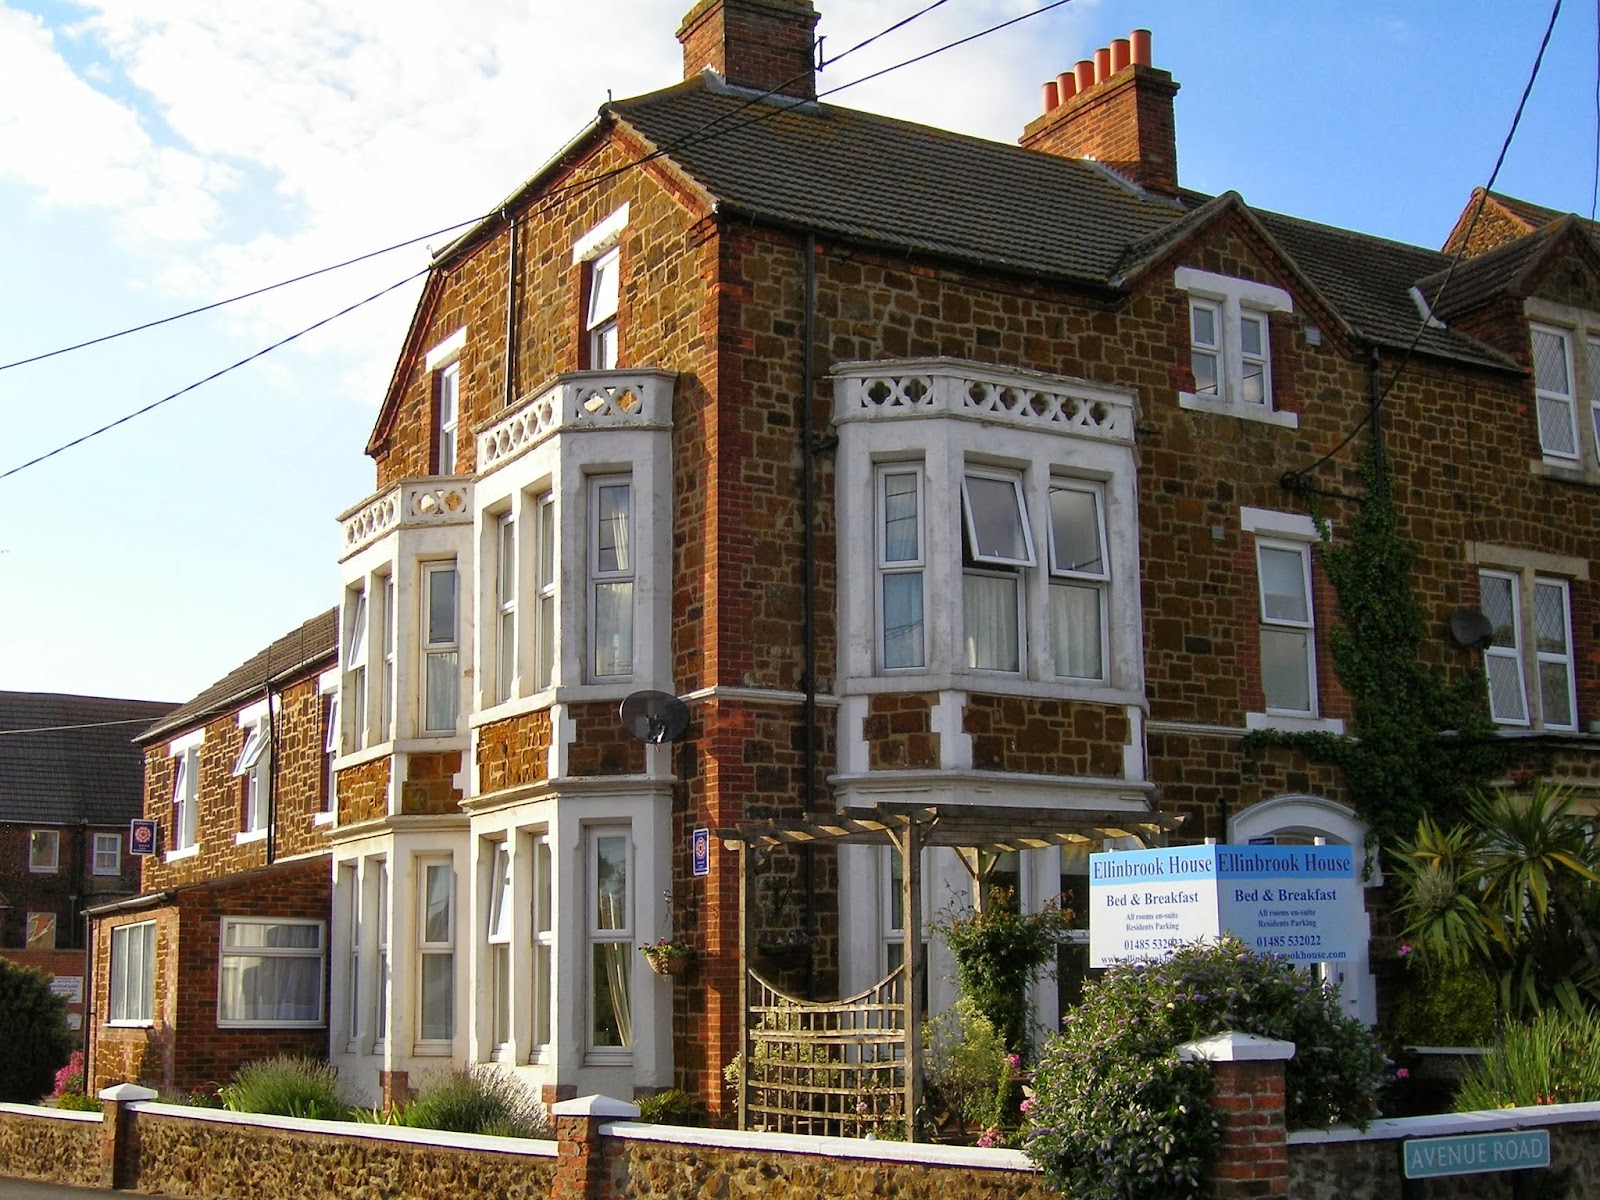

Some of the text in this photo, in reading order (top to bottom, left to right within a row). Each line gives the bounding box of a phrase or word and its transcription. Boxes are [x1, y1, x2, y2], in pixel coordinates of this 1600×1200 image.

[1094, 854, 1213, 880] Ellinbrook House
[1218, 853, 1351, 873] Ellinbrook House
[1106, 891, 1200, 907] Bed & Breakfast
[1235, 888, 1337, 902] Bed & Breakfast
[1126, 913, 1136, 921] All
[1155, 911, 1179, 919] en-suite
[1258, 909, 1268, 917] All
[1290, 908, 1316, 917] en-suite
[1126, 922, 1180, 931] Residents Parking
[1258, 918, 1317, 928] Residents Parking
[1124, 939, 1151, 951] 01485
[1256, 935, 1322, 948] 01485 532022
[1412, 1138, 1544, 1169] AVENUE ROAD
